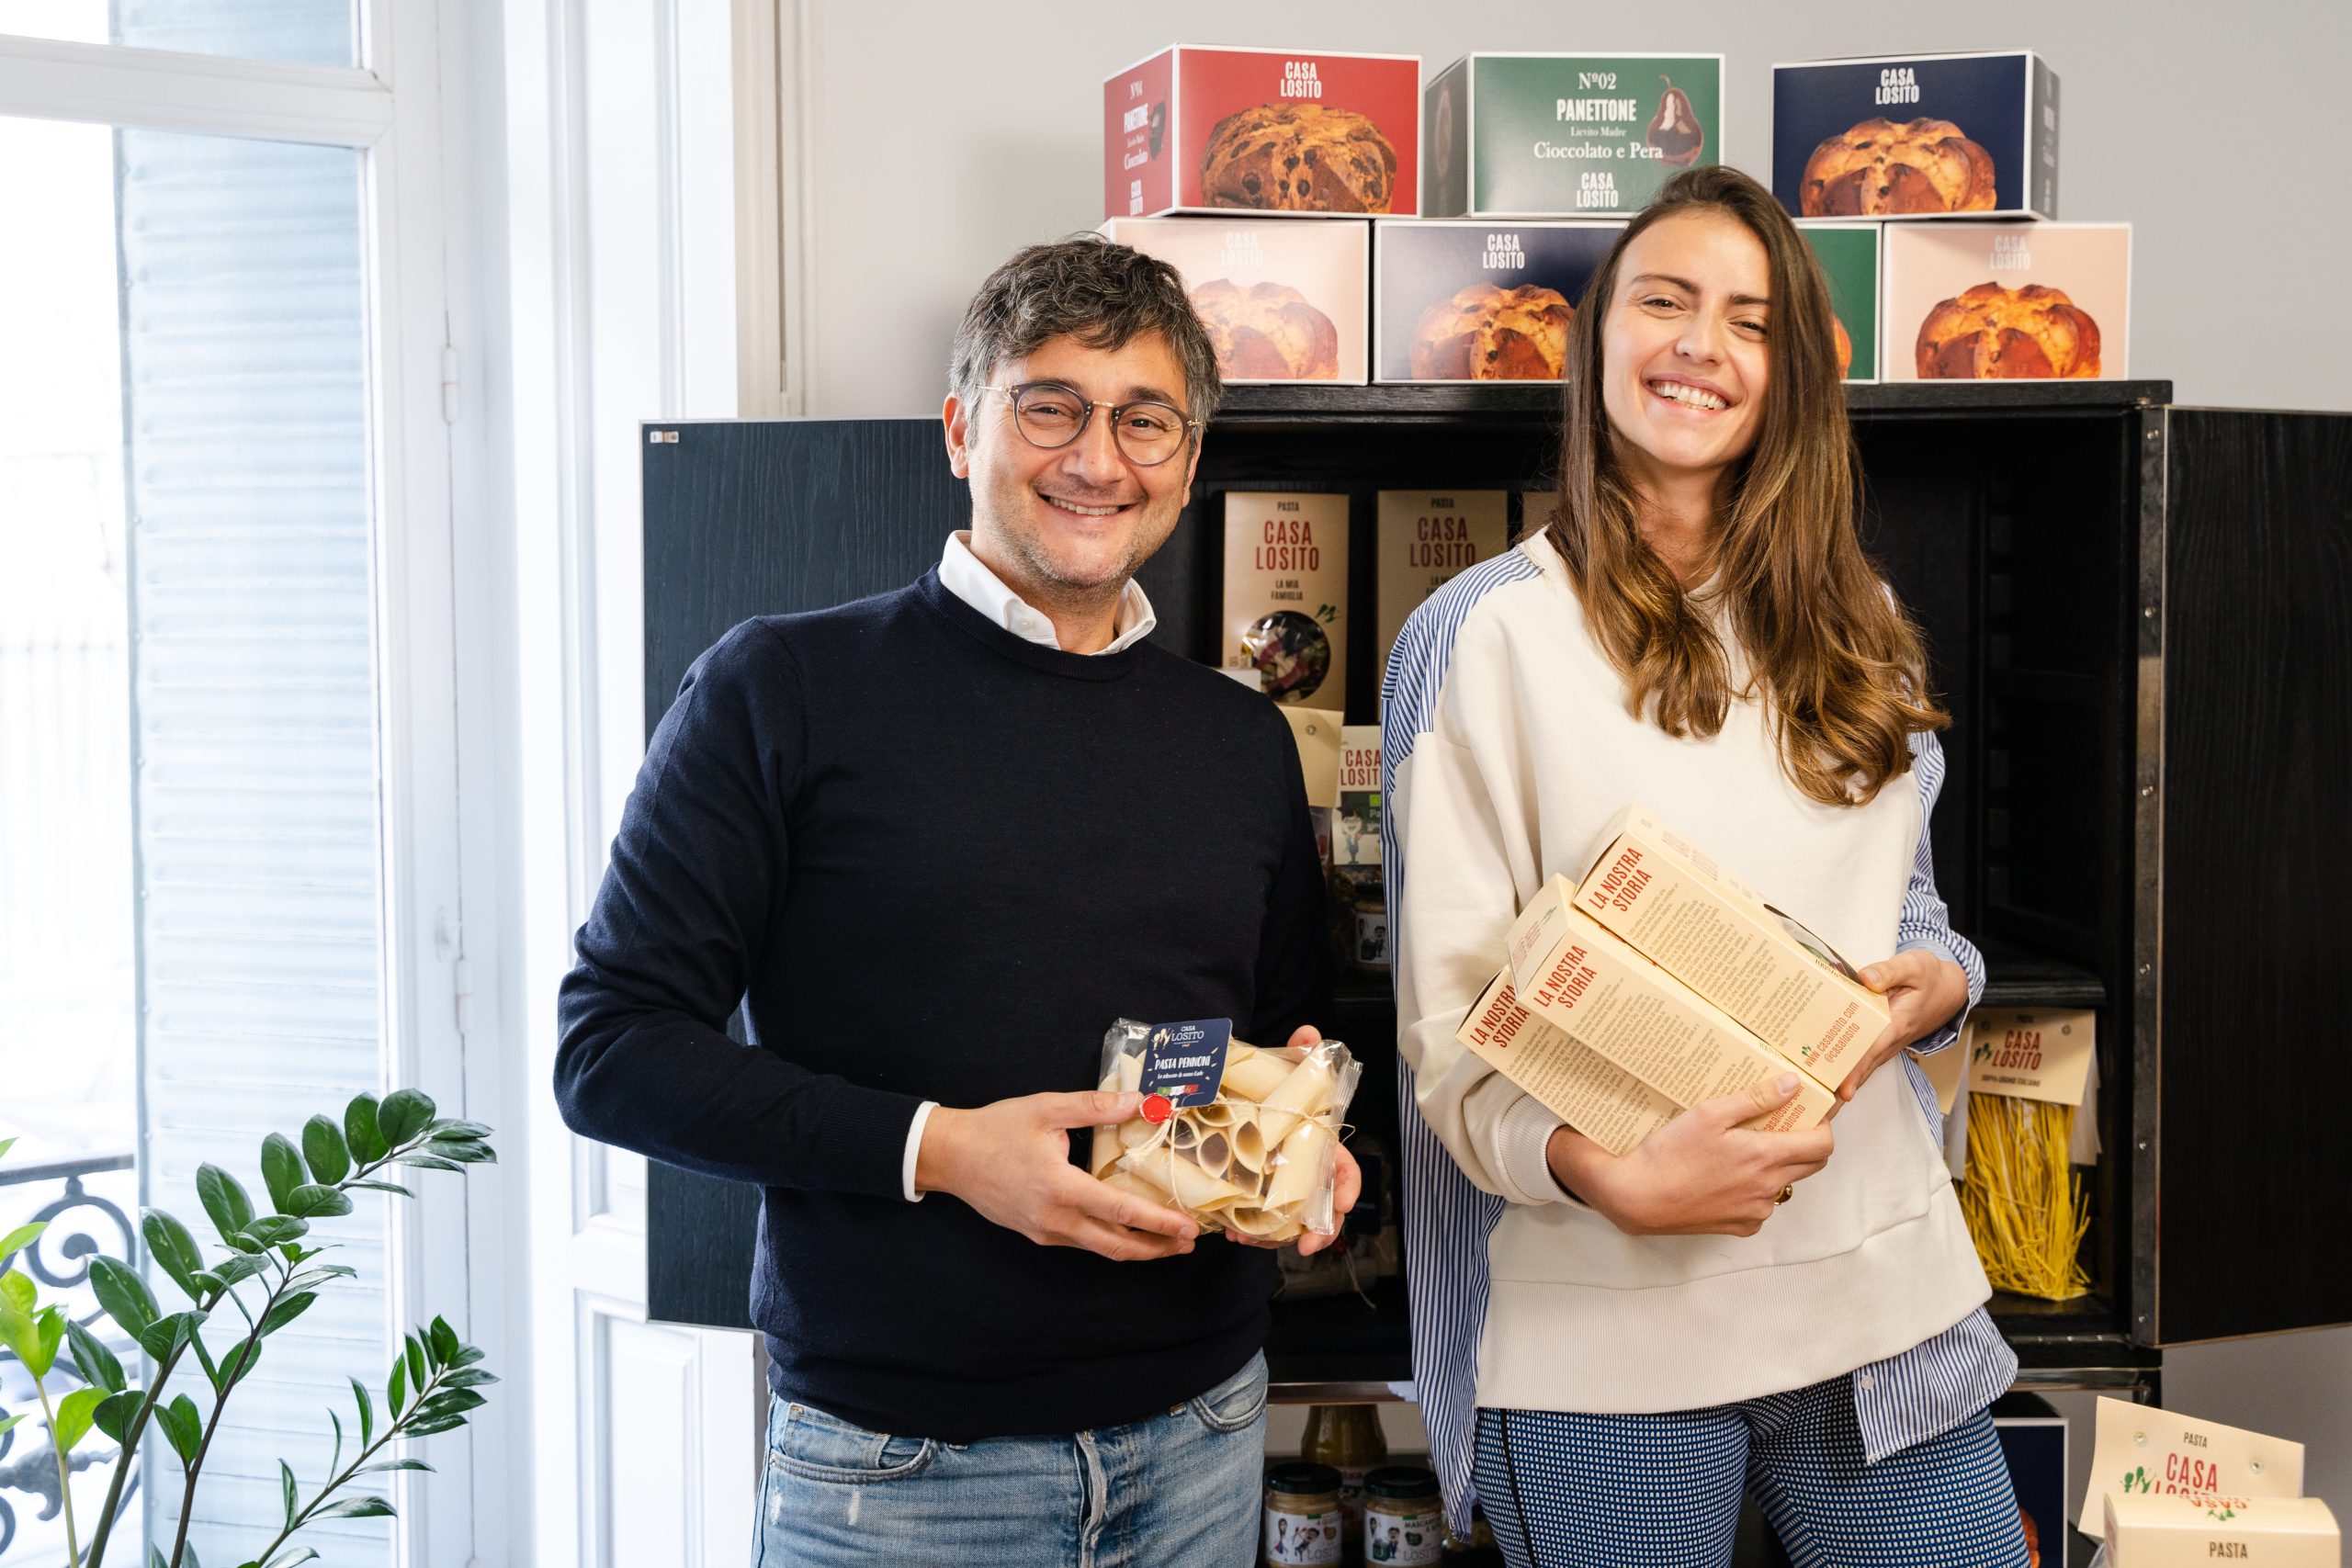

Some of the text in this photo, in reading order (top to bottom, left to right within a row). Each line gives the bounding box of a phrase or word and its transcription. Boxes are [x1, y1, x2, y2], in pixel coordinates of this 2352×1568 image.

[1285, 62, 1317, 80] CASA
[1881, 67, 1916, 87] CASA
[1281, 79, 1322, 98] LOSITO
[1875, 84, 1920, 105] LOSITO
[1556, 99, 1636, 121] PANETTONE
[1570, 127, 1626, 137] Lievito Madre
[1533, 141, 1663, 159] Cioccolato e Pera
[1581, 173, 1613, 190] CASA
[1577, 190, 1618, 208] LOSITO
[1226, 232, 1259, 250] CASA
[1487, 233, 1521, 252] CASA
[1995, 235, 2027, 254] CASA
[1220, 250, 1264, 267] LOSITO
[1483, 251, 1525, 269] LOSITO
[1990, 253, 2031, 270] LOSITO
[1277, 502, 1300, 512] PASTA
[1264, 521, 1313, 545] CASA
[1418, 516, 1468, 541] CASA
[1256, 547, 1319, 570] LOSITO
[1410, 543, 1476, 568] LOSITO
[1275, 580, 1283, 589] LA
[1345, 749, 1381, 767] CASA
[1340, 768, 1378, 786] LOSIT
[1589, 848, 1643, 910] LA NOSTRA
[1612, 869, 1651, 911] STORIA
[1533, 945, 1588, 1008] LA NOSTRA
[1557, 965, 1597, 1009] STORIA
[1470, 985, 1515, 1046] LA NOSTRA
[1170, 1031, 1204, 1041] LOSITO
[1491, 1006, 1530, 1049] STORIA
[1824, 1022, 1860, 1063] @casalosito
[2005, 1030, 2041, 1050] CASA
[1155, 1057, 1177, 1070] PASTA
[1991, 1049, 2042, 1070] LOSITO
[2184, 1431, 2208, 1449] PASTA
[2166, 1452, 2217, 1493] CASA
[2209, 1541, 2248, 1559] PASTA
